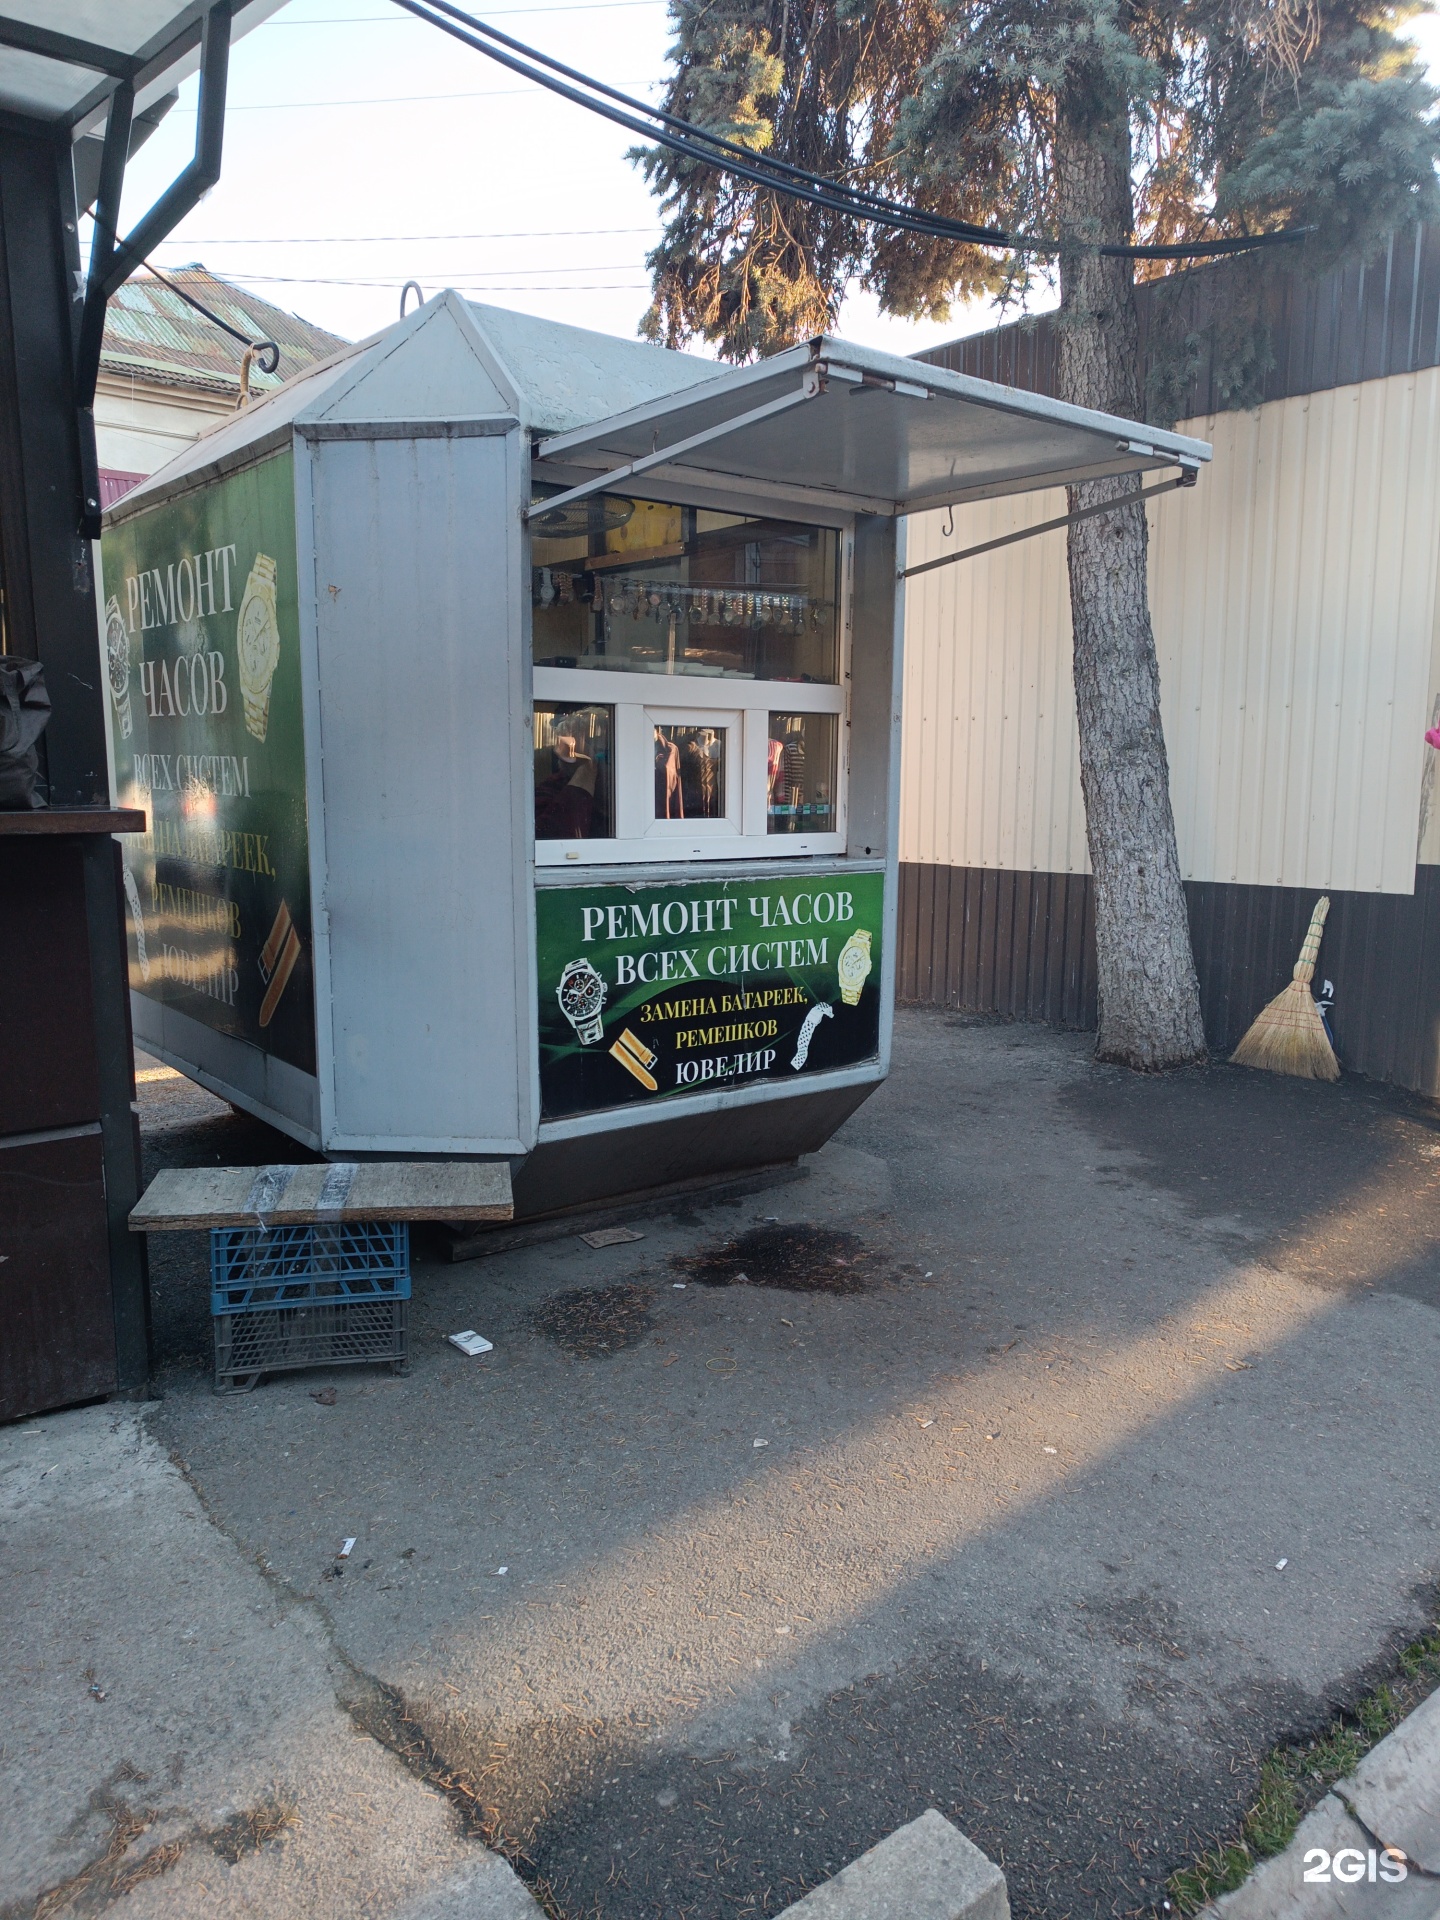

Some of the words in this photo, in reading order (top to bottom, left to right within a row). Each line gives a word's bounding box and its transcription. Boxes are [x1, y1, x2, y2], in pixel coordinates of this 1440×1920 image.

[126, 543, 236, 633] РЕМОНТ
[139, 650, 228, 718] ЧАСОВ
[133, 753, 174, 791] ВСЕХ
[175, 754, 250, 798] СИСТЕМ
[581, 898, 738, 942] РЕМОНТ
[748, 891, 855, 929] ЧАСОВ
[615, 950, 701, 985] ВСЕХ
[707, 937, 829, 976] СИСТЕМ
[640, 997, 716, 1023] ЗАМЕНА
[721, 986, 808, 1013] БАТАРЕЕК,
[675, 1019, 778, 1049] РЕМЕШКОВ
[675, 1049, 776, 1084] ЮВЕЛИР
